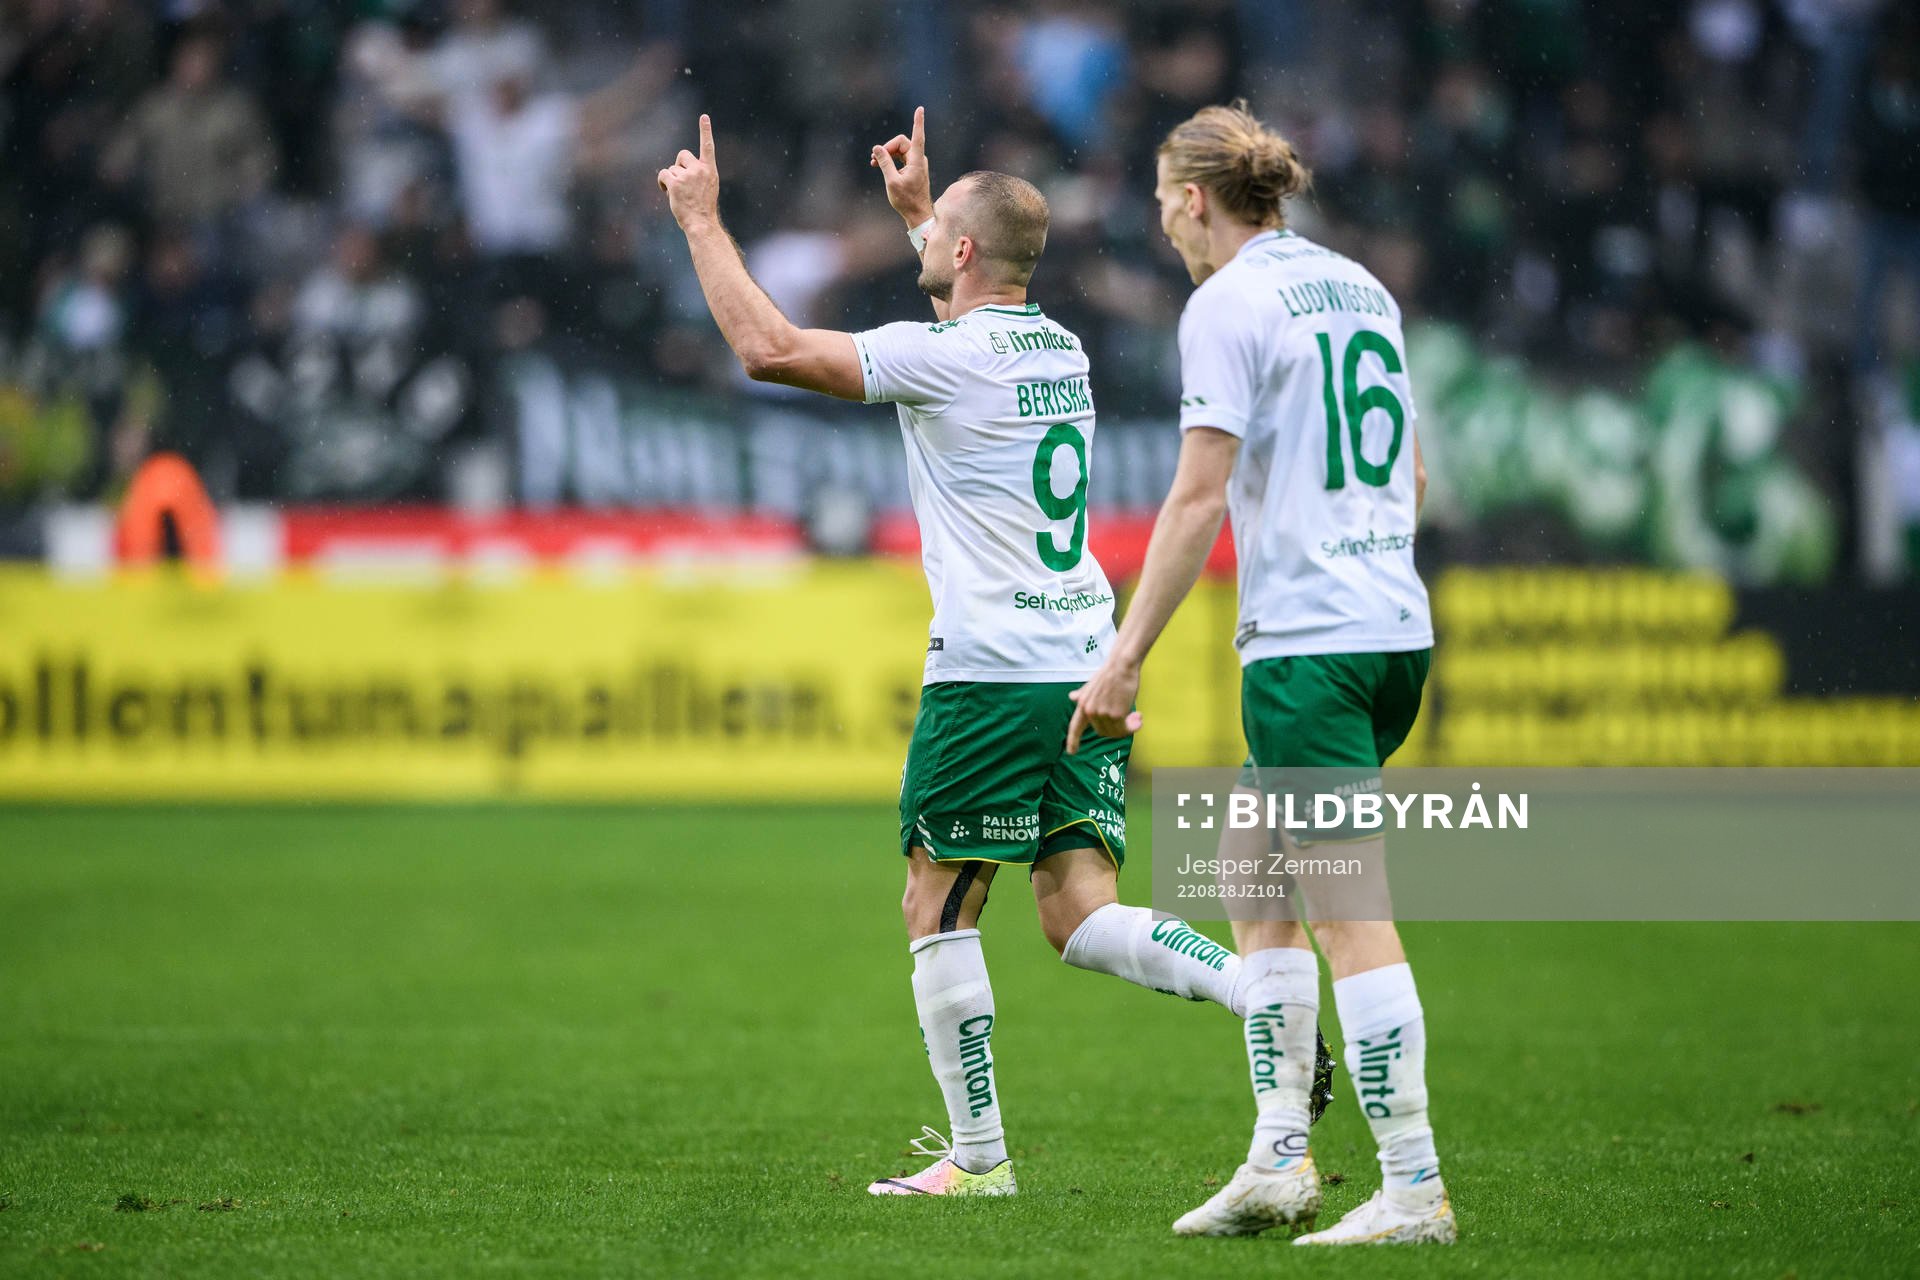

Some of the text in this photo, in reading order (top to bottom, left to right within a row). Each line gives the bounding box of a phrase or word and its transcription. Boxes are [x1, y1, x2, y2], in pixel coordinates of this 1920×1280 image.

[1278, 279, 1392, 317] LUDWIGSON
[1016, 379, 1090, 417] BERISHA
[1315, 330, 1404, 490] 16
[1033, 423, 1089, 572] 9
